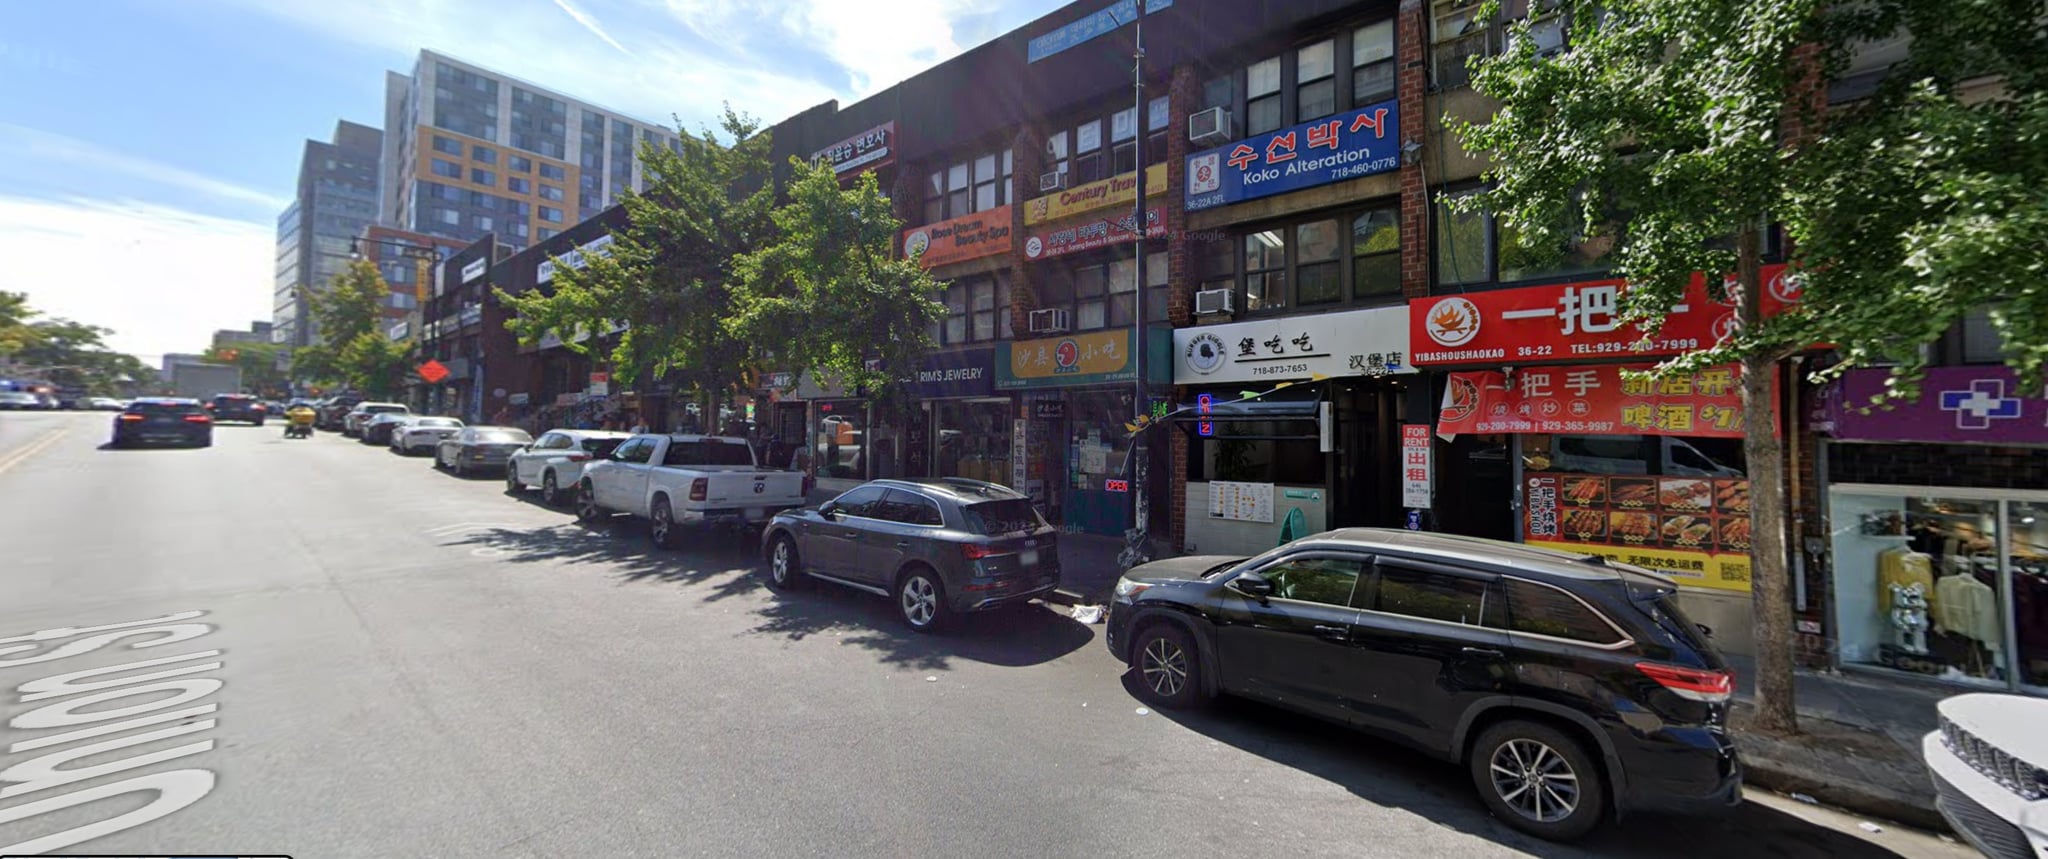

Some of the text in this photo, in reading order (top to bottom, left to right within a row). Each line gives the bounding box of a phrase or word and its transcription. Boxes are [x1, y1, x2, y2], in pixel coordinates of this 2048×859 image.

[1228, 108, 1388, 170] 수선박사
[1243, 168, 1280, 185] Koko
[1285, 147, 1370, 177] Alteration
[1331, 156, 1397, 180] 718-460-0776
[1060, 183, 1108, 206] Century
[1110, 170, 1149, 193] Trav
[1502, 285, 1690, 337] 一把
[1238, 331, 1313, 357] 堡吃吃
[1415, 348, 1505, 361] YIBASHOUSHAOKAO
[1518, 346, 1552, 356] 36-22
[1253, 364, 1308, 375] 718-873-7653
[1349, 351, 1402, 369] 汉堡店
[943, 367, 983, 381] JEWELRY
[1486, 370, 1601, 398] 一把手
[1623, 404, 1692, 430] 啤酒
[1405, 438, 1429, 447] RENT
[1407, 428, 1426, 437] FOR
[1407, 453, 1428, 482] 出租
[1108, 481, 1128, 491] OPEN
